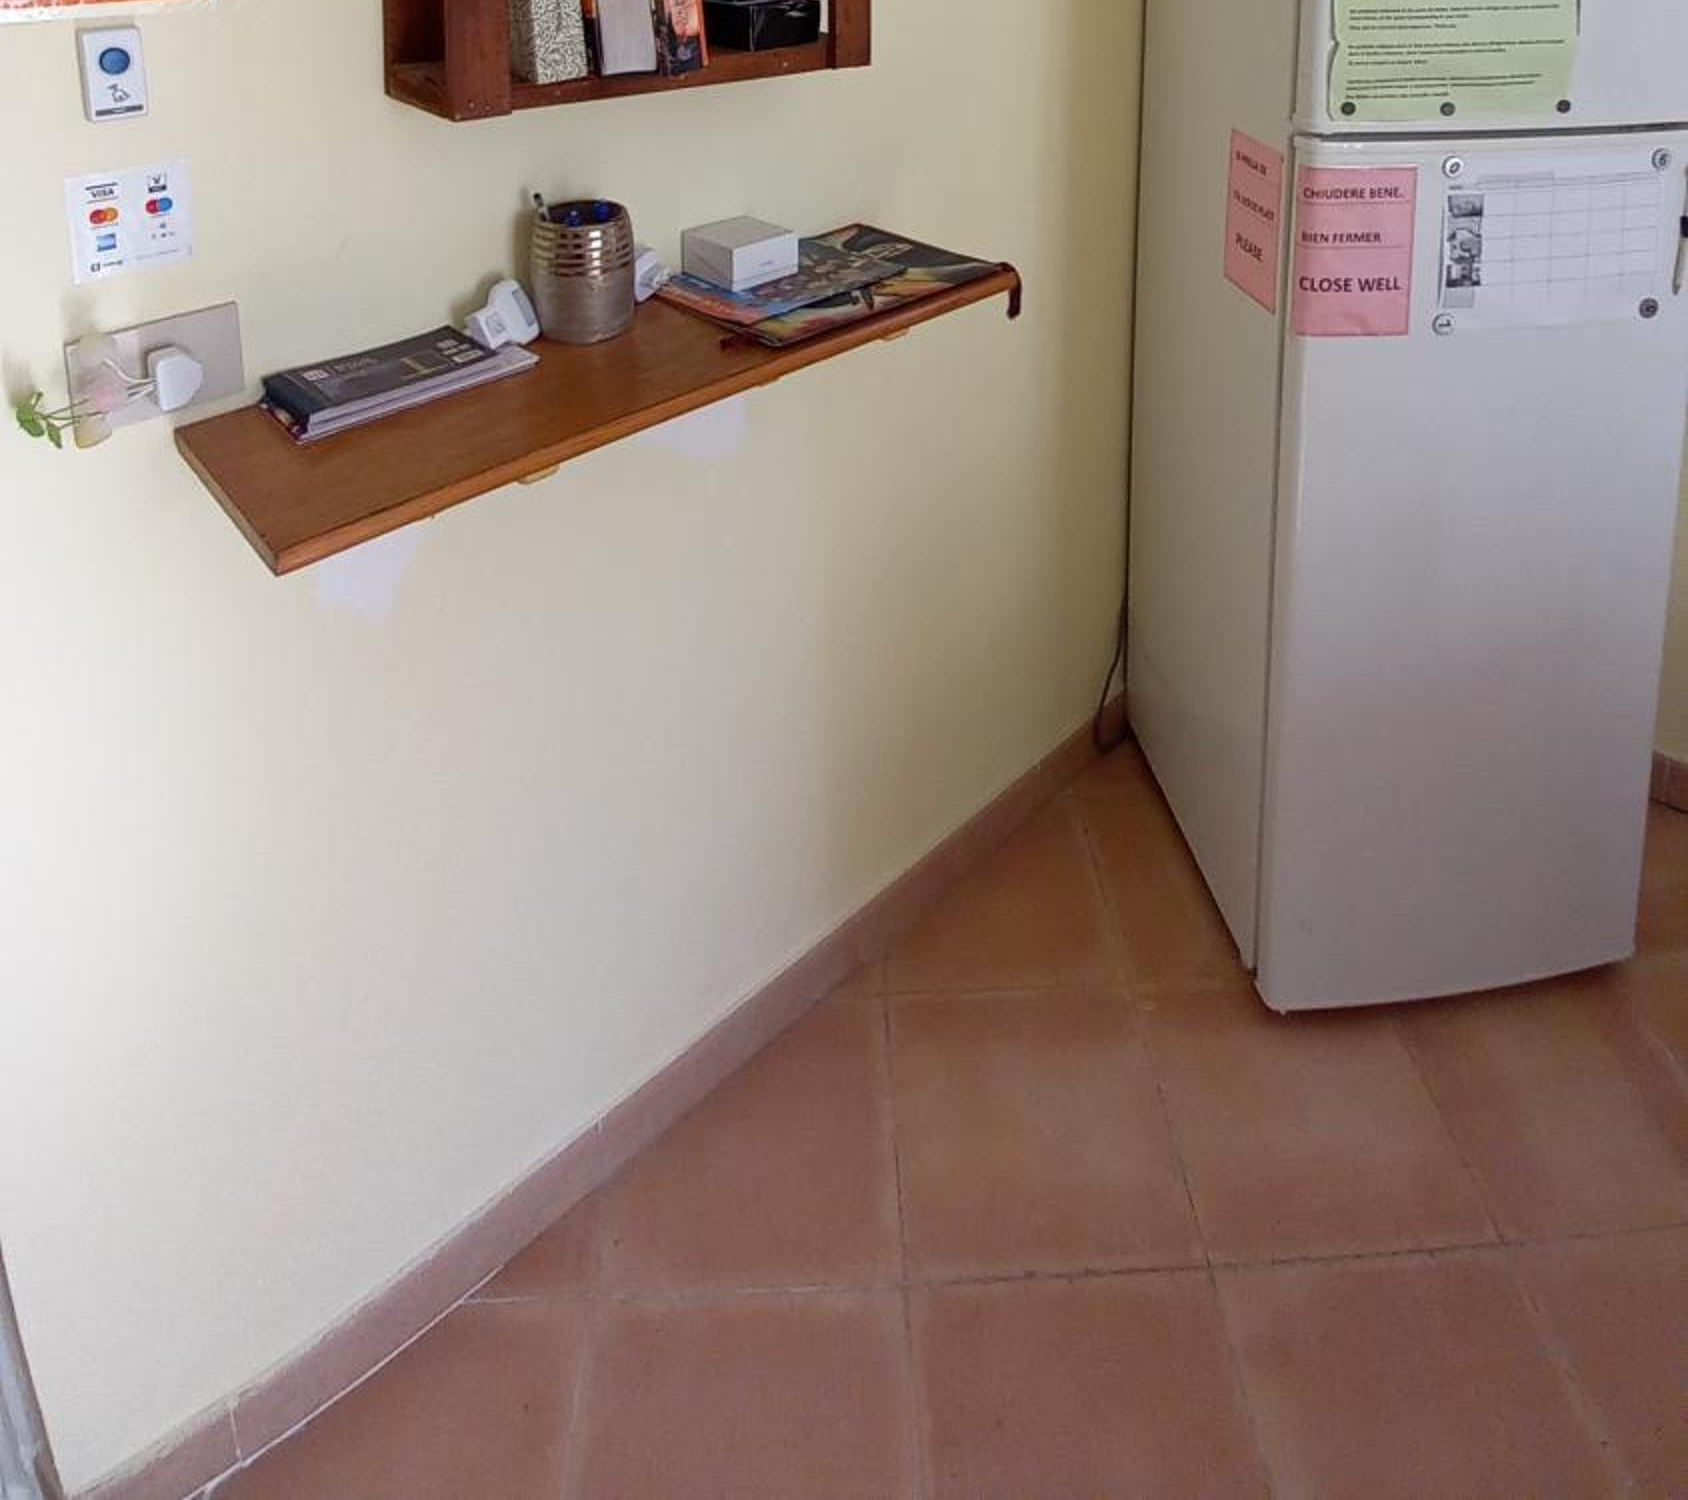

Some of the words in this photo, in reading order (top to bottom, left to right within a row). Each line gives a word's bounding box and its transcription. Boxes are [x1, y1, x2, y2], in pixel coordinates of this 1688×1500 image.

[90, 187, 115, 199] VISA
[1303, 187, 1367, 199] CHIUDERE
[1301, 231, 1329, 243] BIEN
[1331, 232, 1382, 244] FERMER
[1299, 276, 1353, 293] CLOSE
[1357, 276, 1402, 293] WELL
